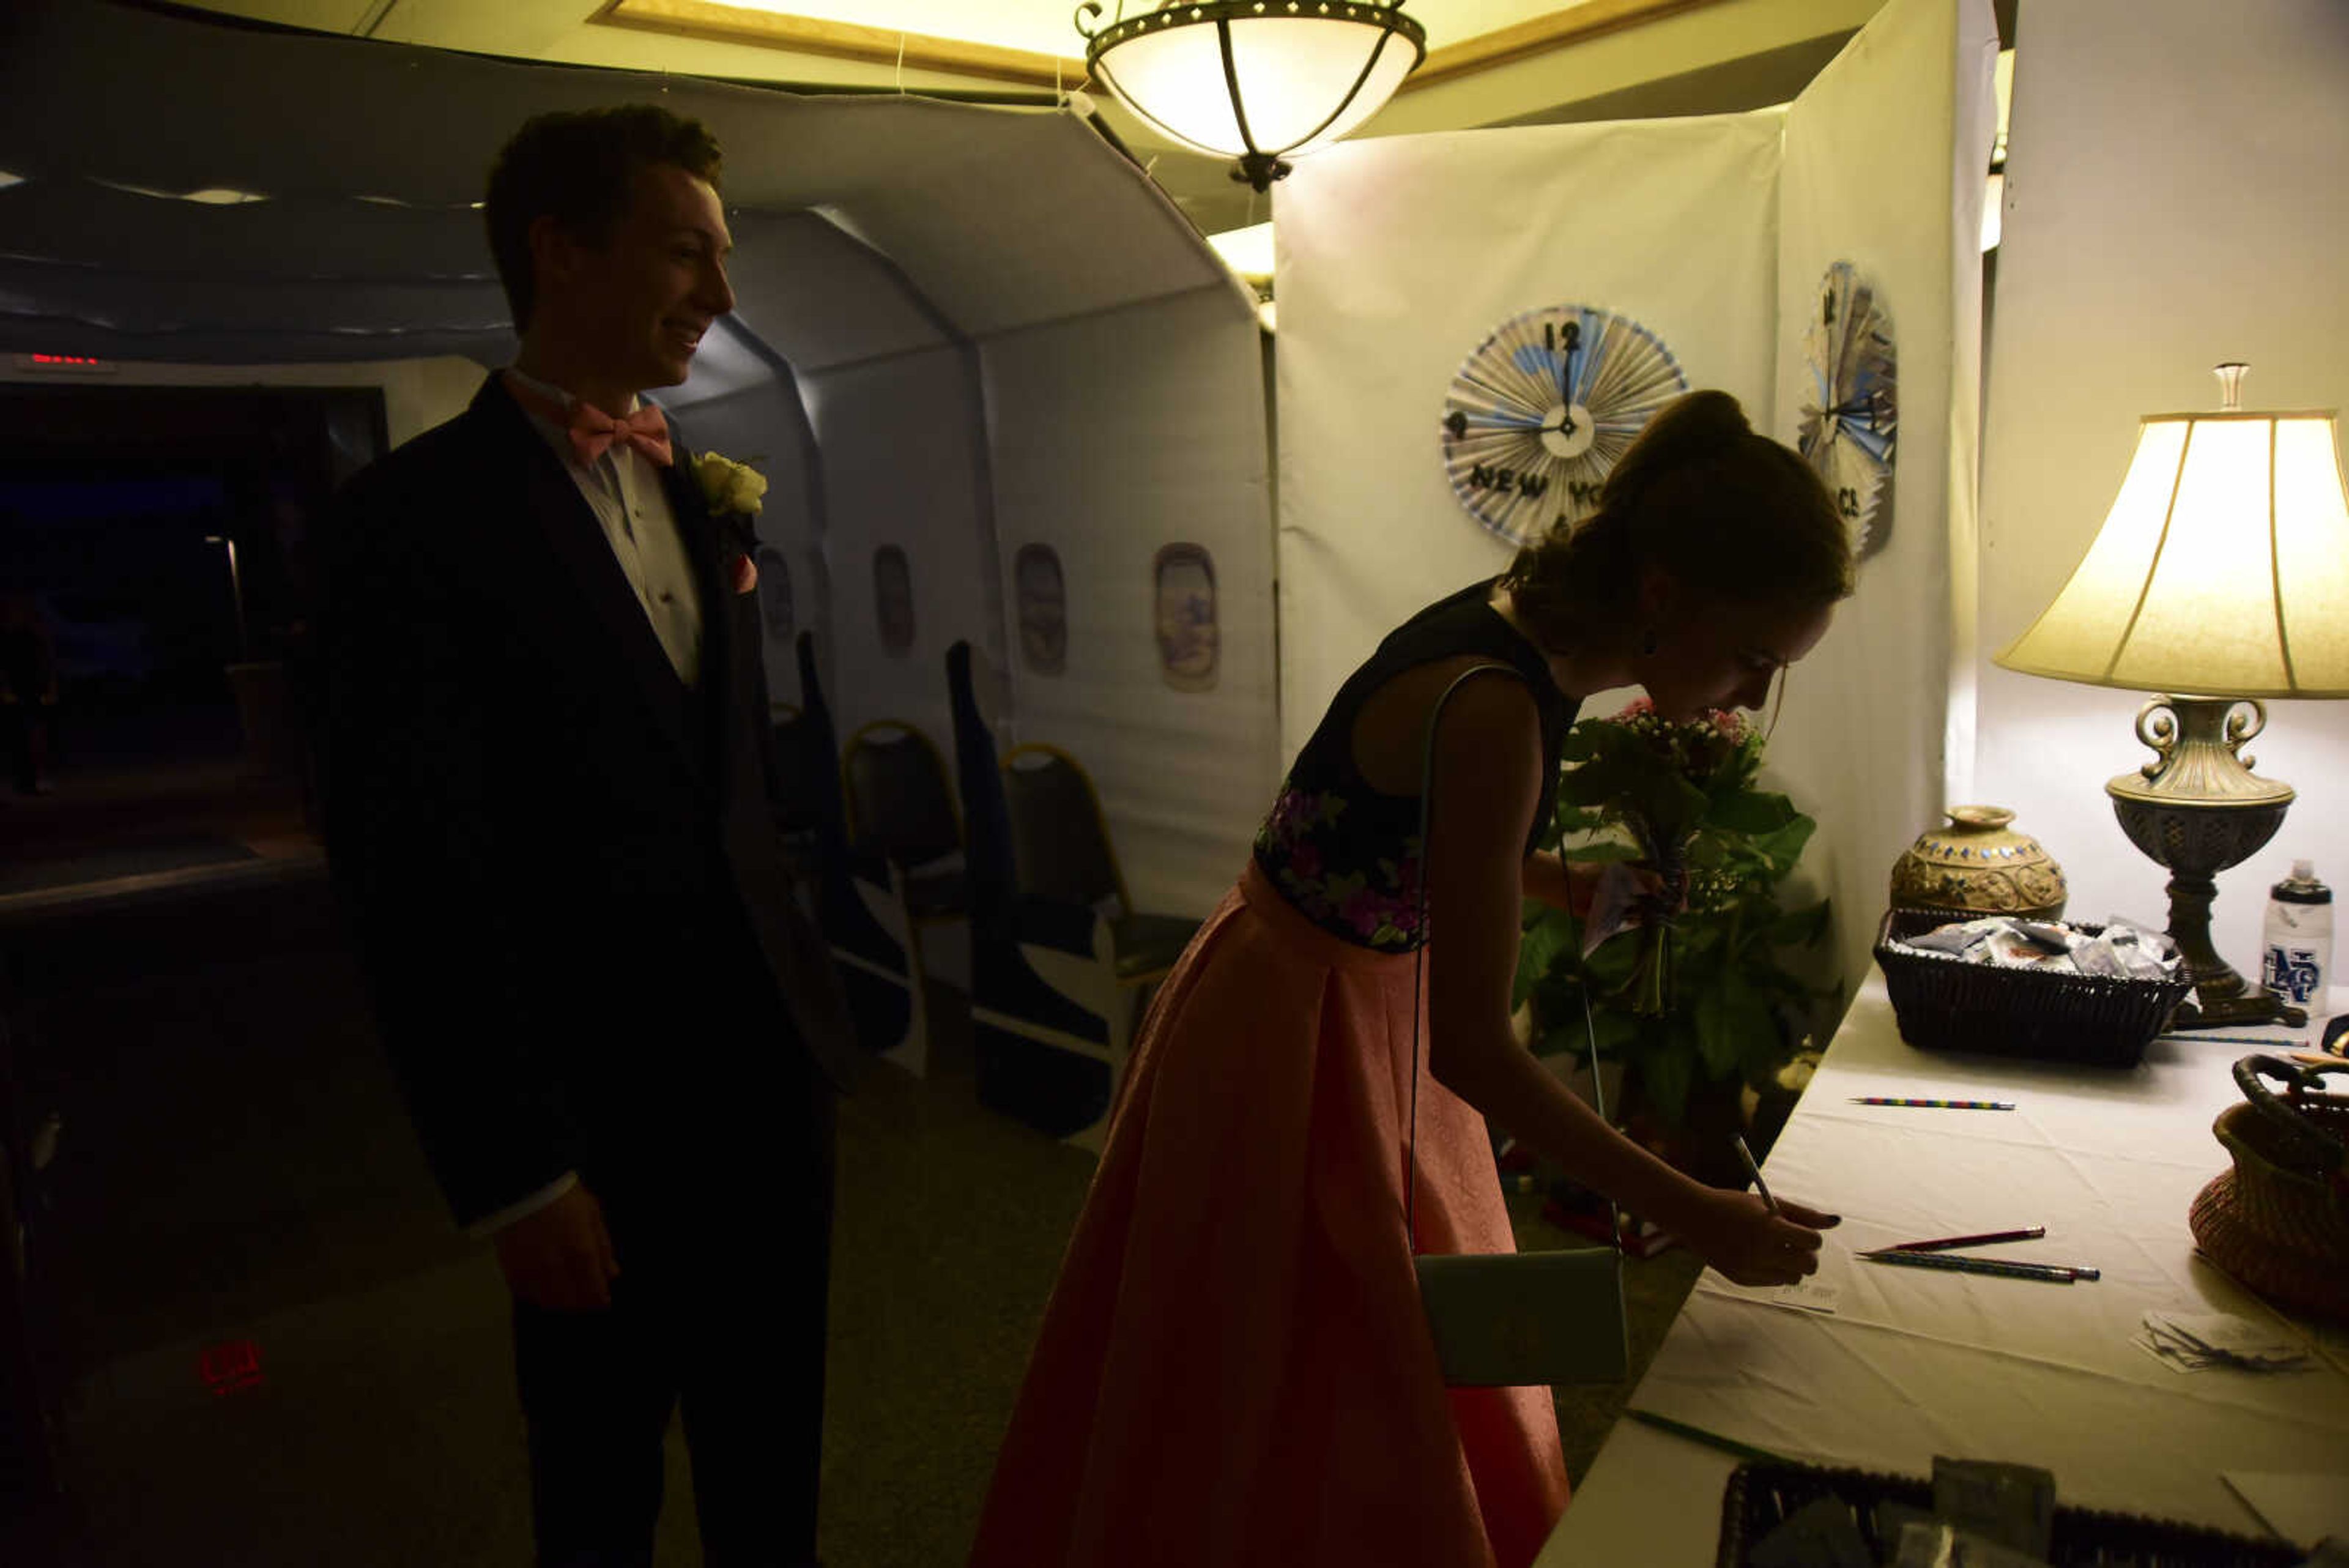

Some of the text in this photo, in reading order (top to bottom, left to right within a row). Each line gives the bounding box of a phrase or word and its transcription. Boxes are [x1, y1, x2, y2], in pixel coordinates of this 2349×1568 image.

[1545, 321, 1580, 351] 12
[1446, 411, 1468, 439] 9
[1470, 463, 1549, 498] NEW
